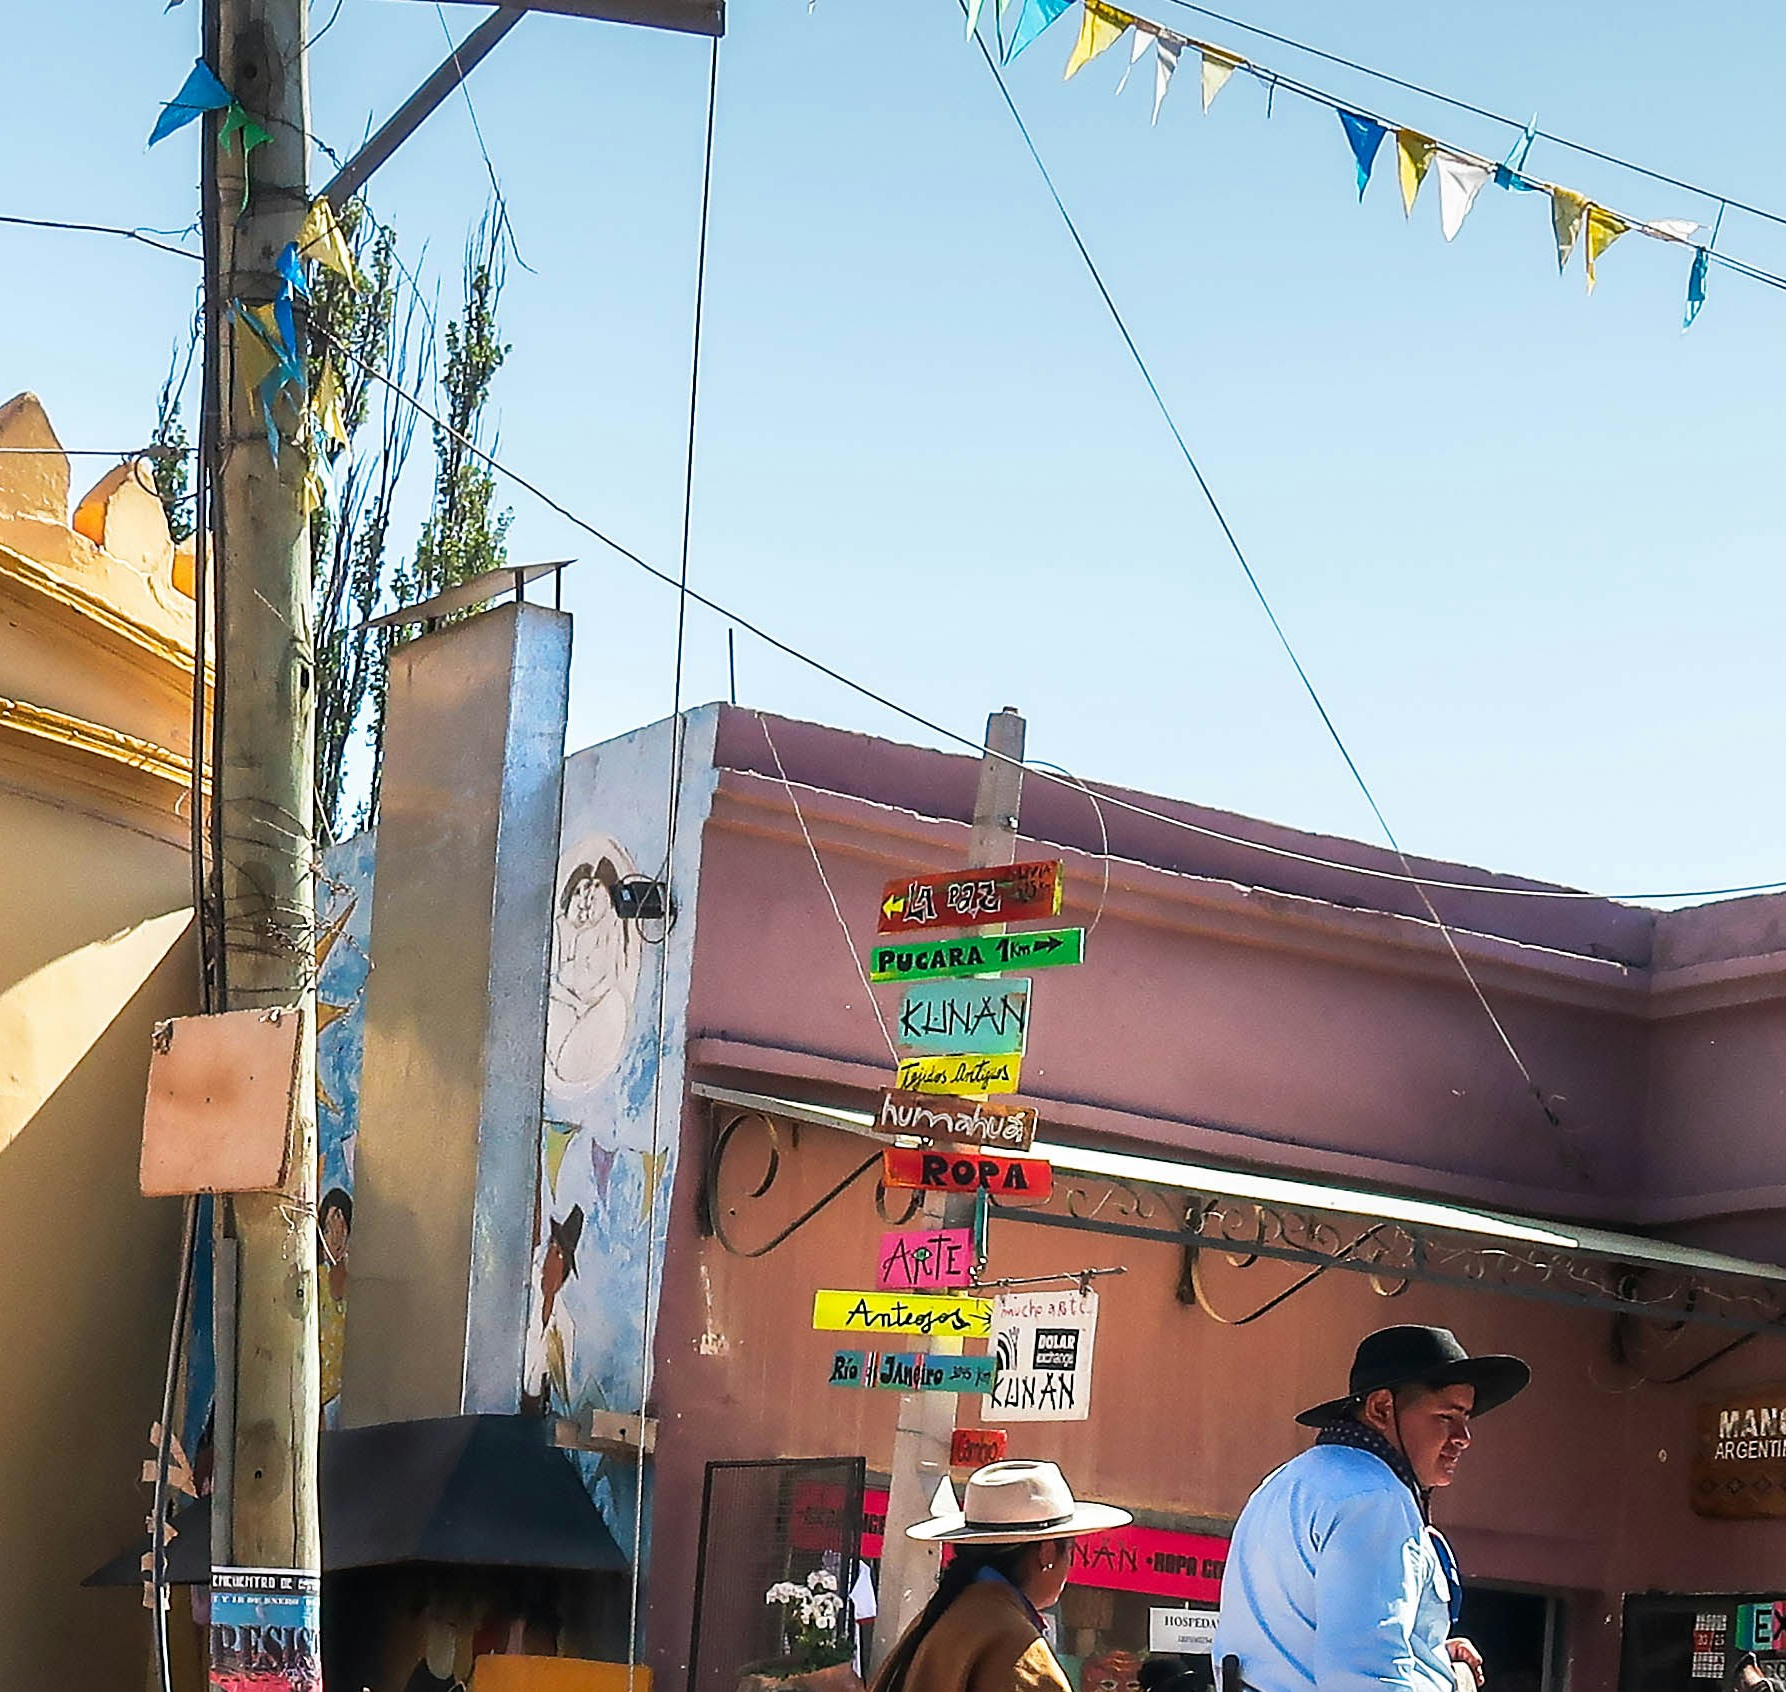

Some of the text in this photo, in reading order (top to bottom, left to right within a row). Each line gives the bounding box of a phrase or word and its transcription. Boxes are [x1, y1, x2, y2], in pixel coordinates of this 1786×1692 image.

[878, 945, 985, 973] PUCARA
[921, 1154, 1028, 1190] ROPA
[883, 1234, 963, 1285] ARTE
[845, 1298, 971, 1334] Anteojos
[1037, 1334, 1076, 1350] DOLAR
[280, 1577, 293, 1590] DE
